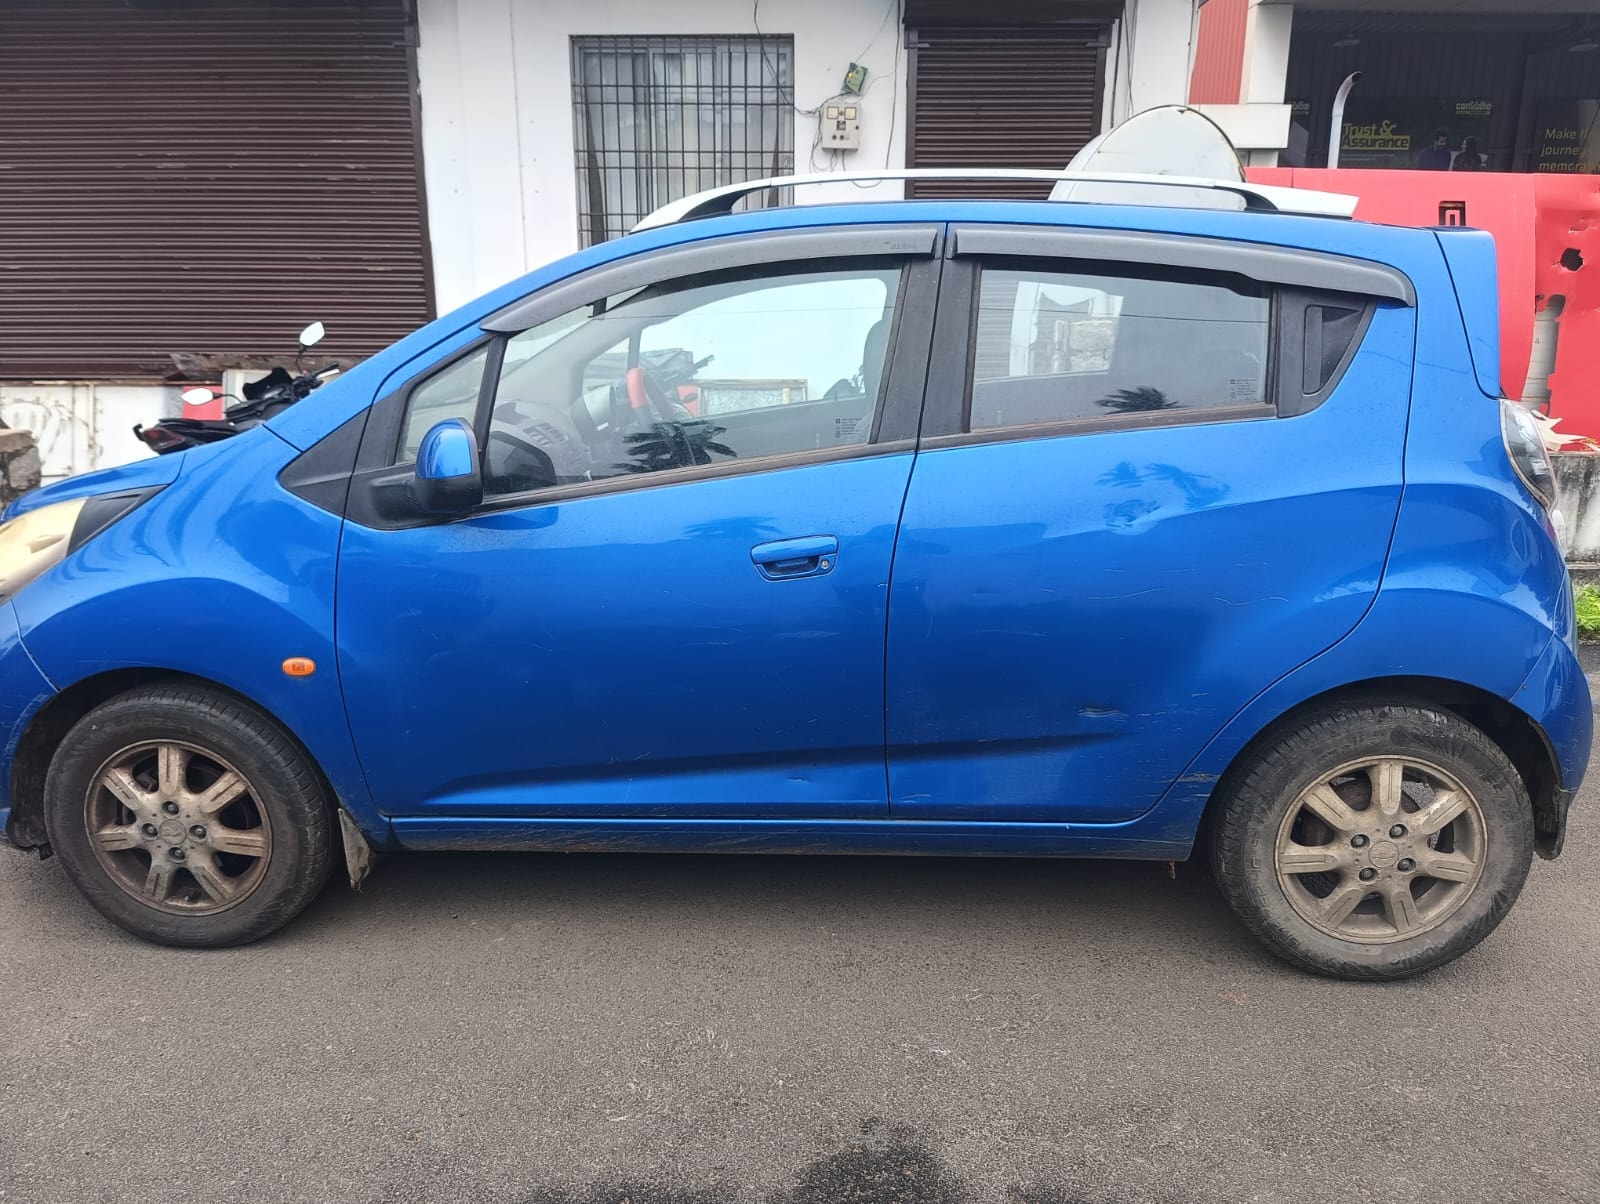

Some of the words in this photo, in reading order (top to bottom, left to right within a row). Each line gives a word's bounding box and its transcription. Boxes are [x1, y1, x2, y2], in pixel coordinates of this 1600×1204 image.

[1343, 122, 1377, 136] Trust
[1380, 119, 1398, 136] &
[1544, 127, 1577, 140] Make
[1342, 135, 1409, 148] Assurance
